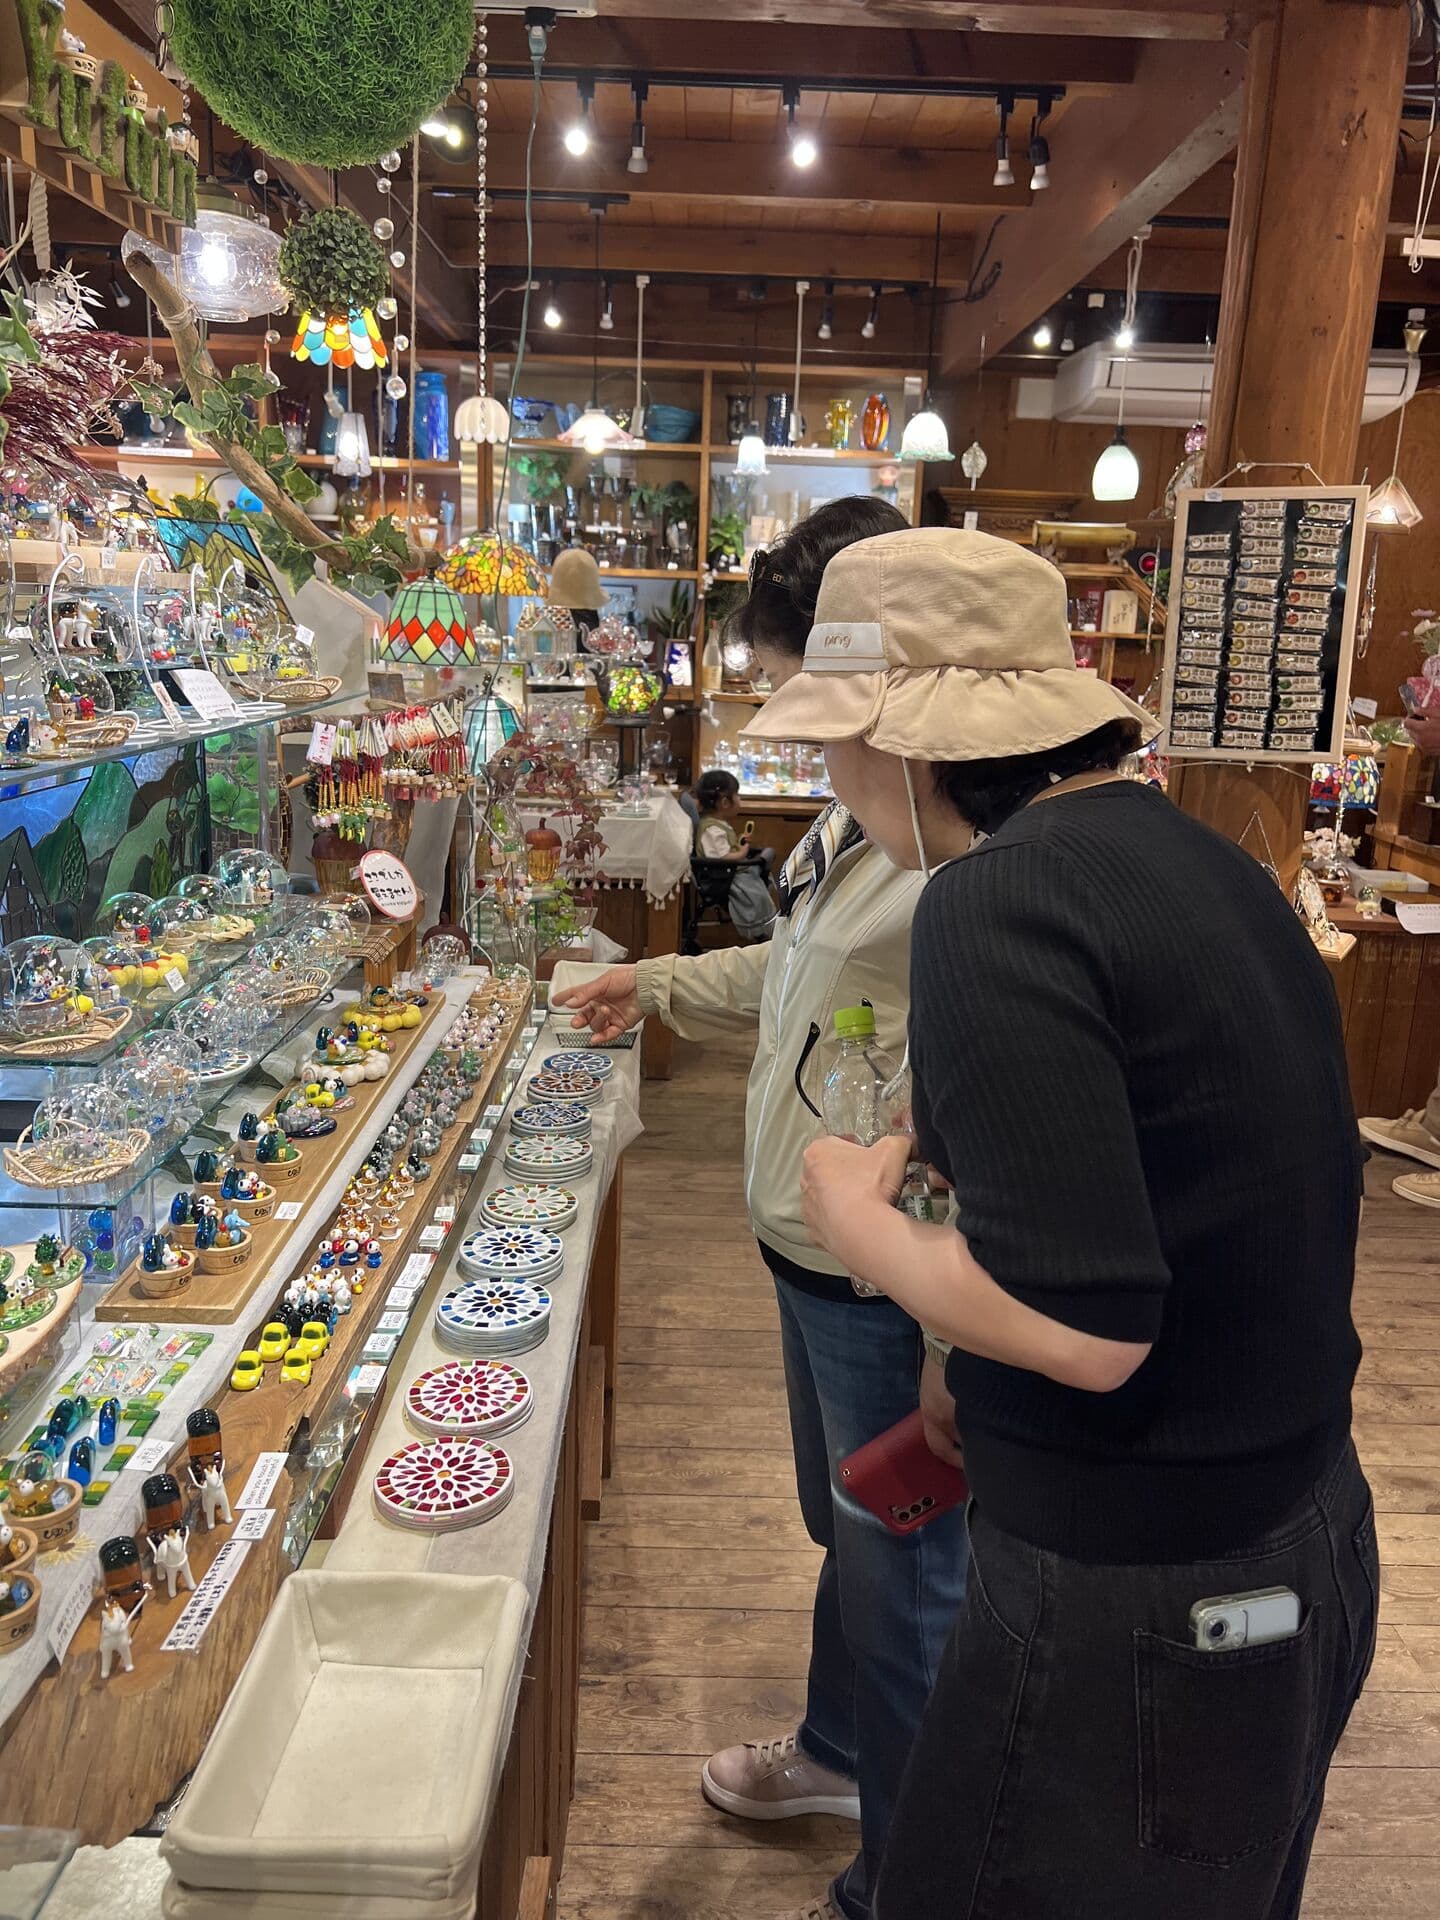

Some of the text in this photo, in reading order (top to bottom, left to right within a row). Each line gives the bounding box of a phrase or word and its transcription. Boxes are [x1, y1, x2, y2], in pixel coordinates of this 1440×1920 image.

[364, 868, 404, 882] ここでしか
[255, 1485, 267, 1504] please
